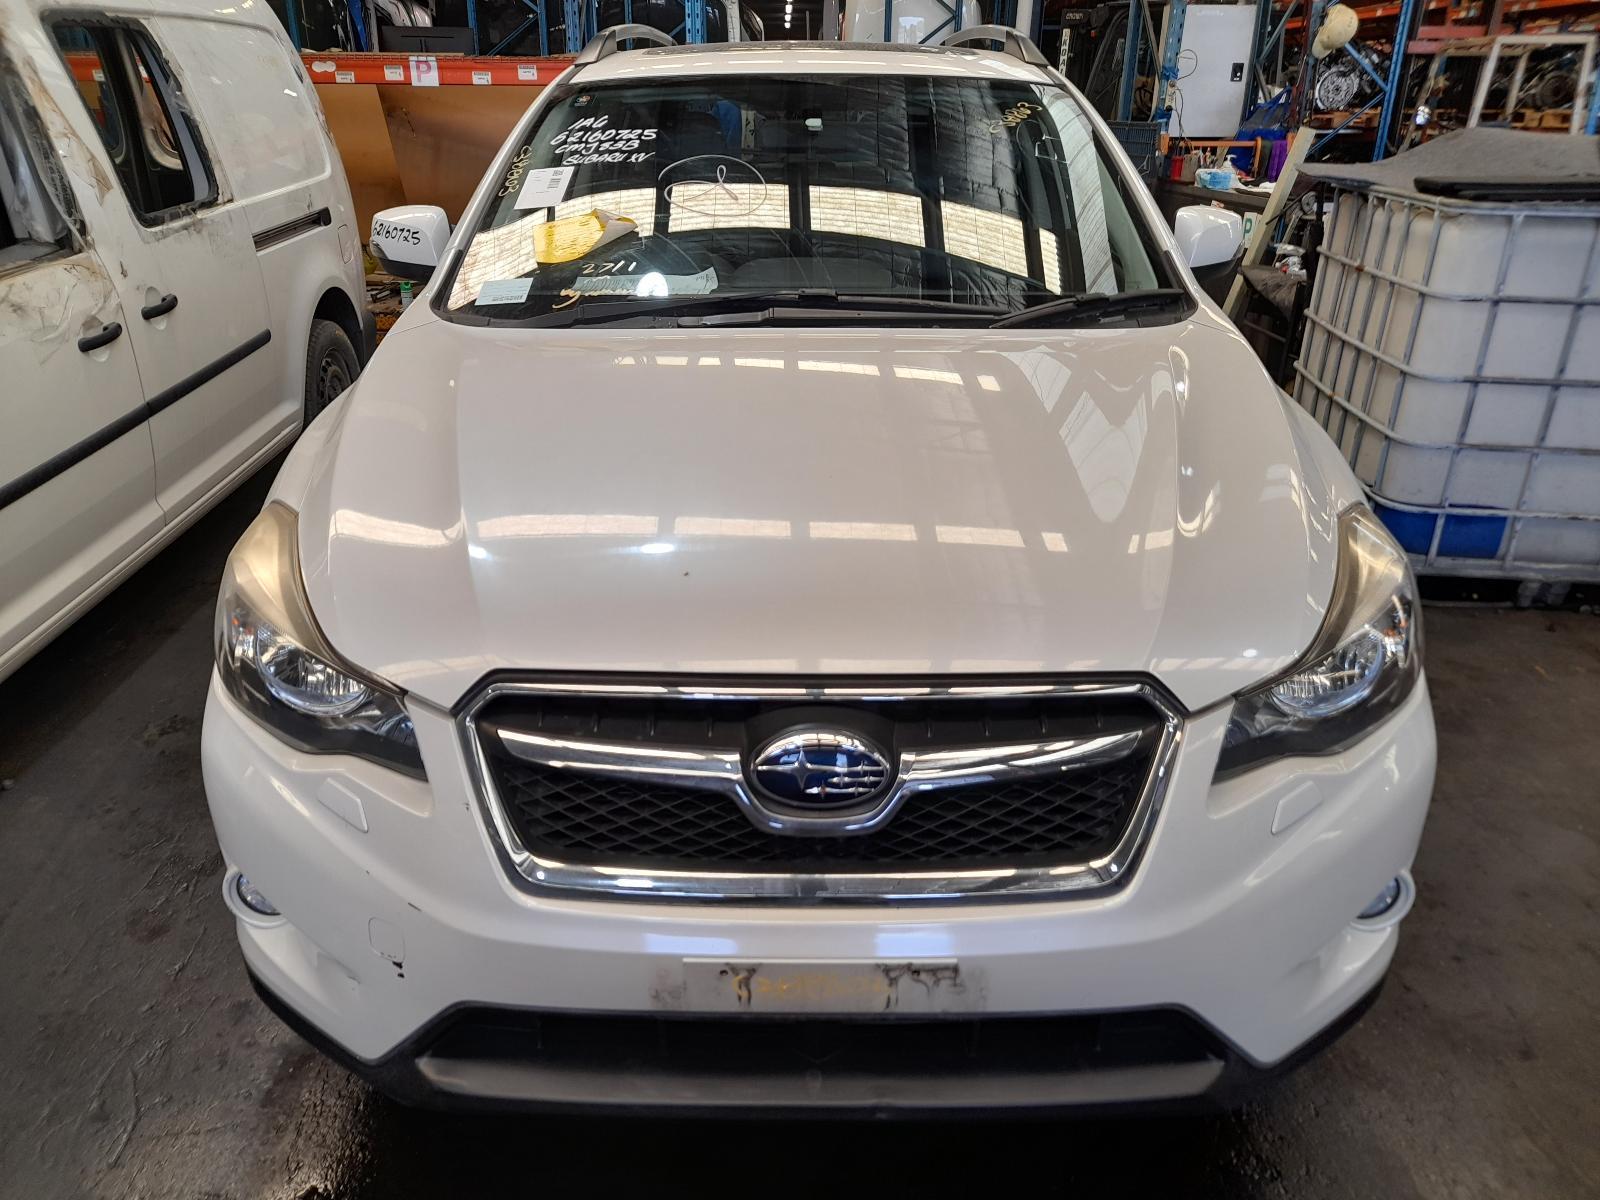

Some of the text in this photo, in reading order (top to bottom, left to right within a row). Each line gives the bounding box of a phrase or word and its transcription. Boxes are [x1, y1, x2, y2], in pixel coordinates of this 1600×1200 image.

[415, 60, 432, 83] P
[550, 128, 659, 146] 62160725
[562, 151, 657, 166] SUBARU XV
[372, 221, 421, 246] 62160725
